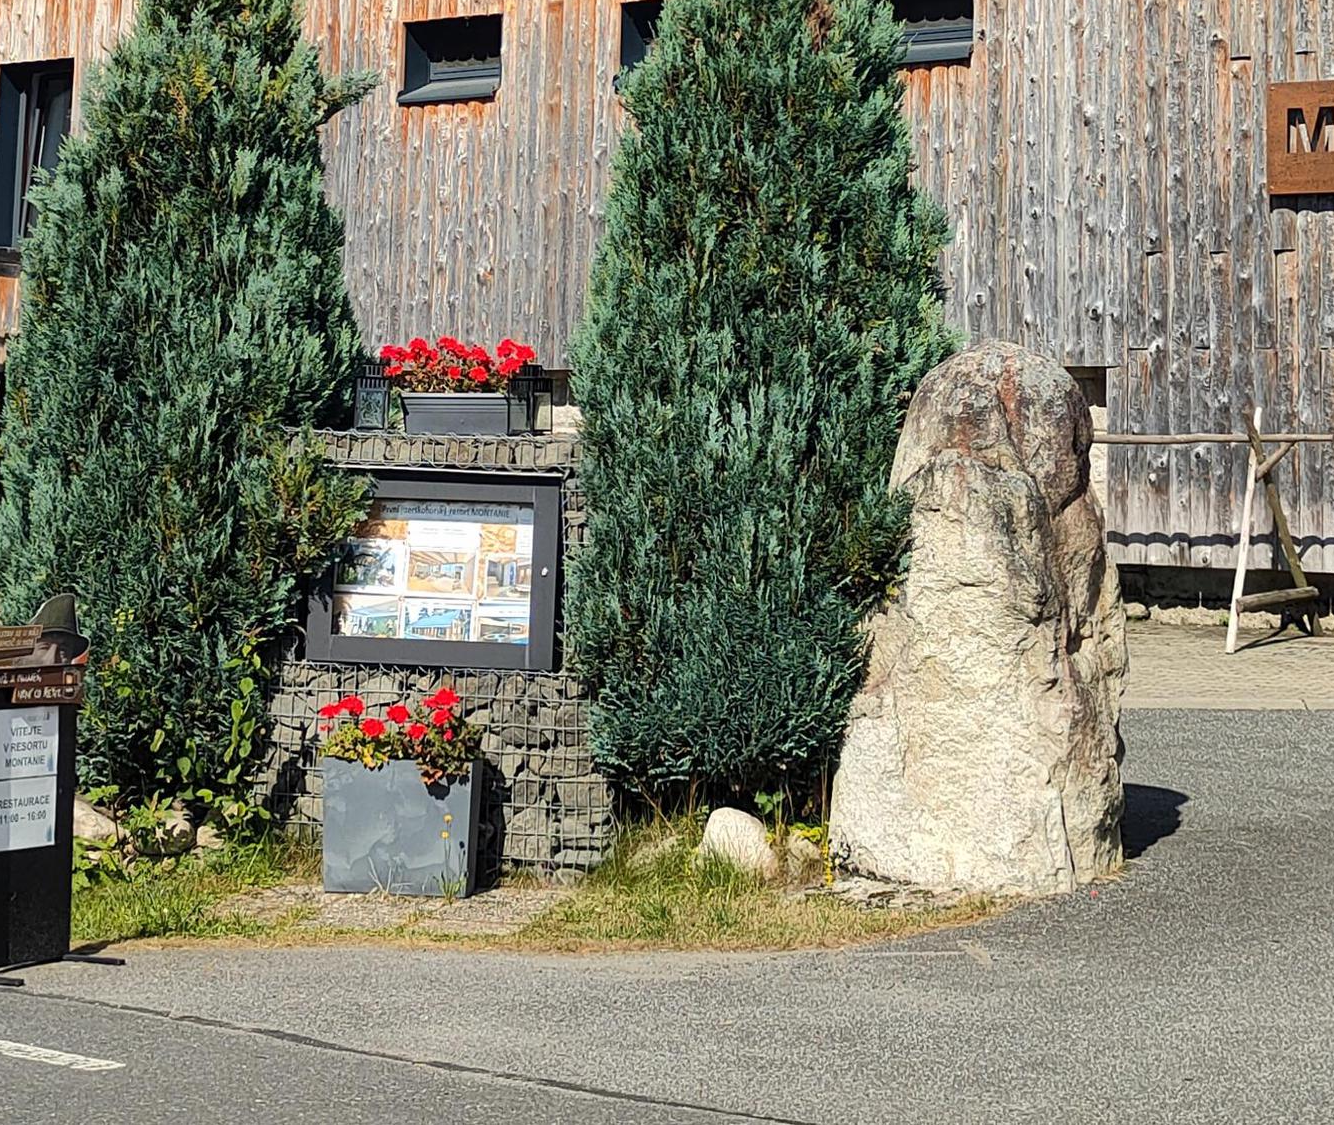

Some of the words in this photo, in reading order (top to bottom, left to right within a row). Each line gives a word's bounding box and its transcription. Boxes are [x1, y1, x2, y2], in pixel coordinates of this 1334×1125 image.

[3, 742, 9, 753] V
[10, 739, 48, 752] RESORTU
[5, 755, 46, 768] MONTANIE
[0, 813, 19, 825] 11:00
